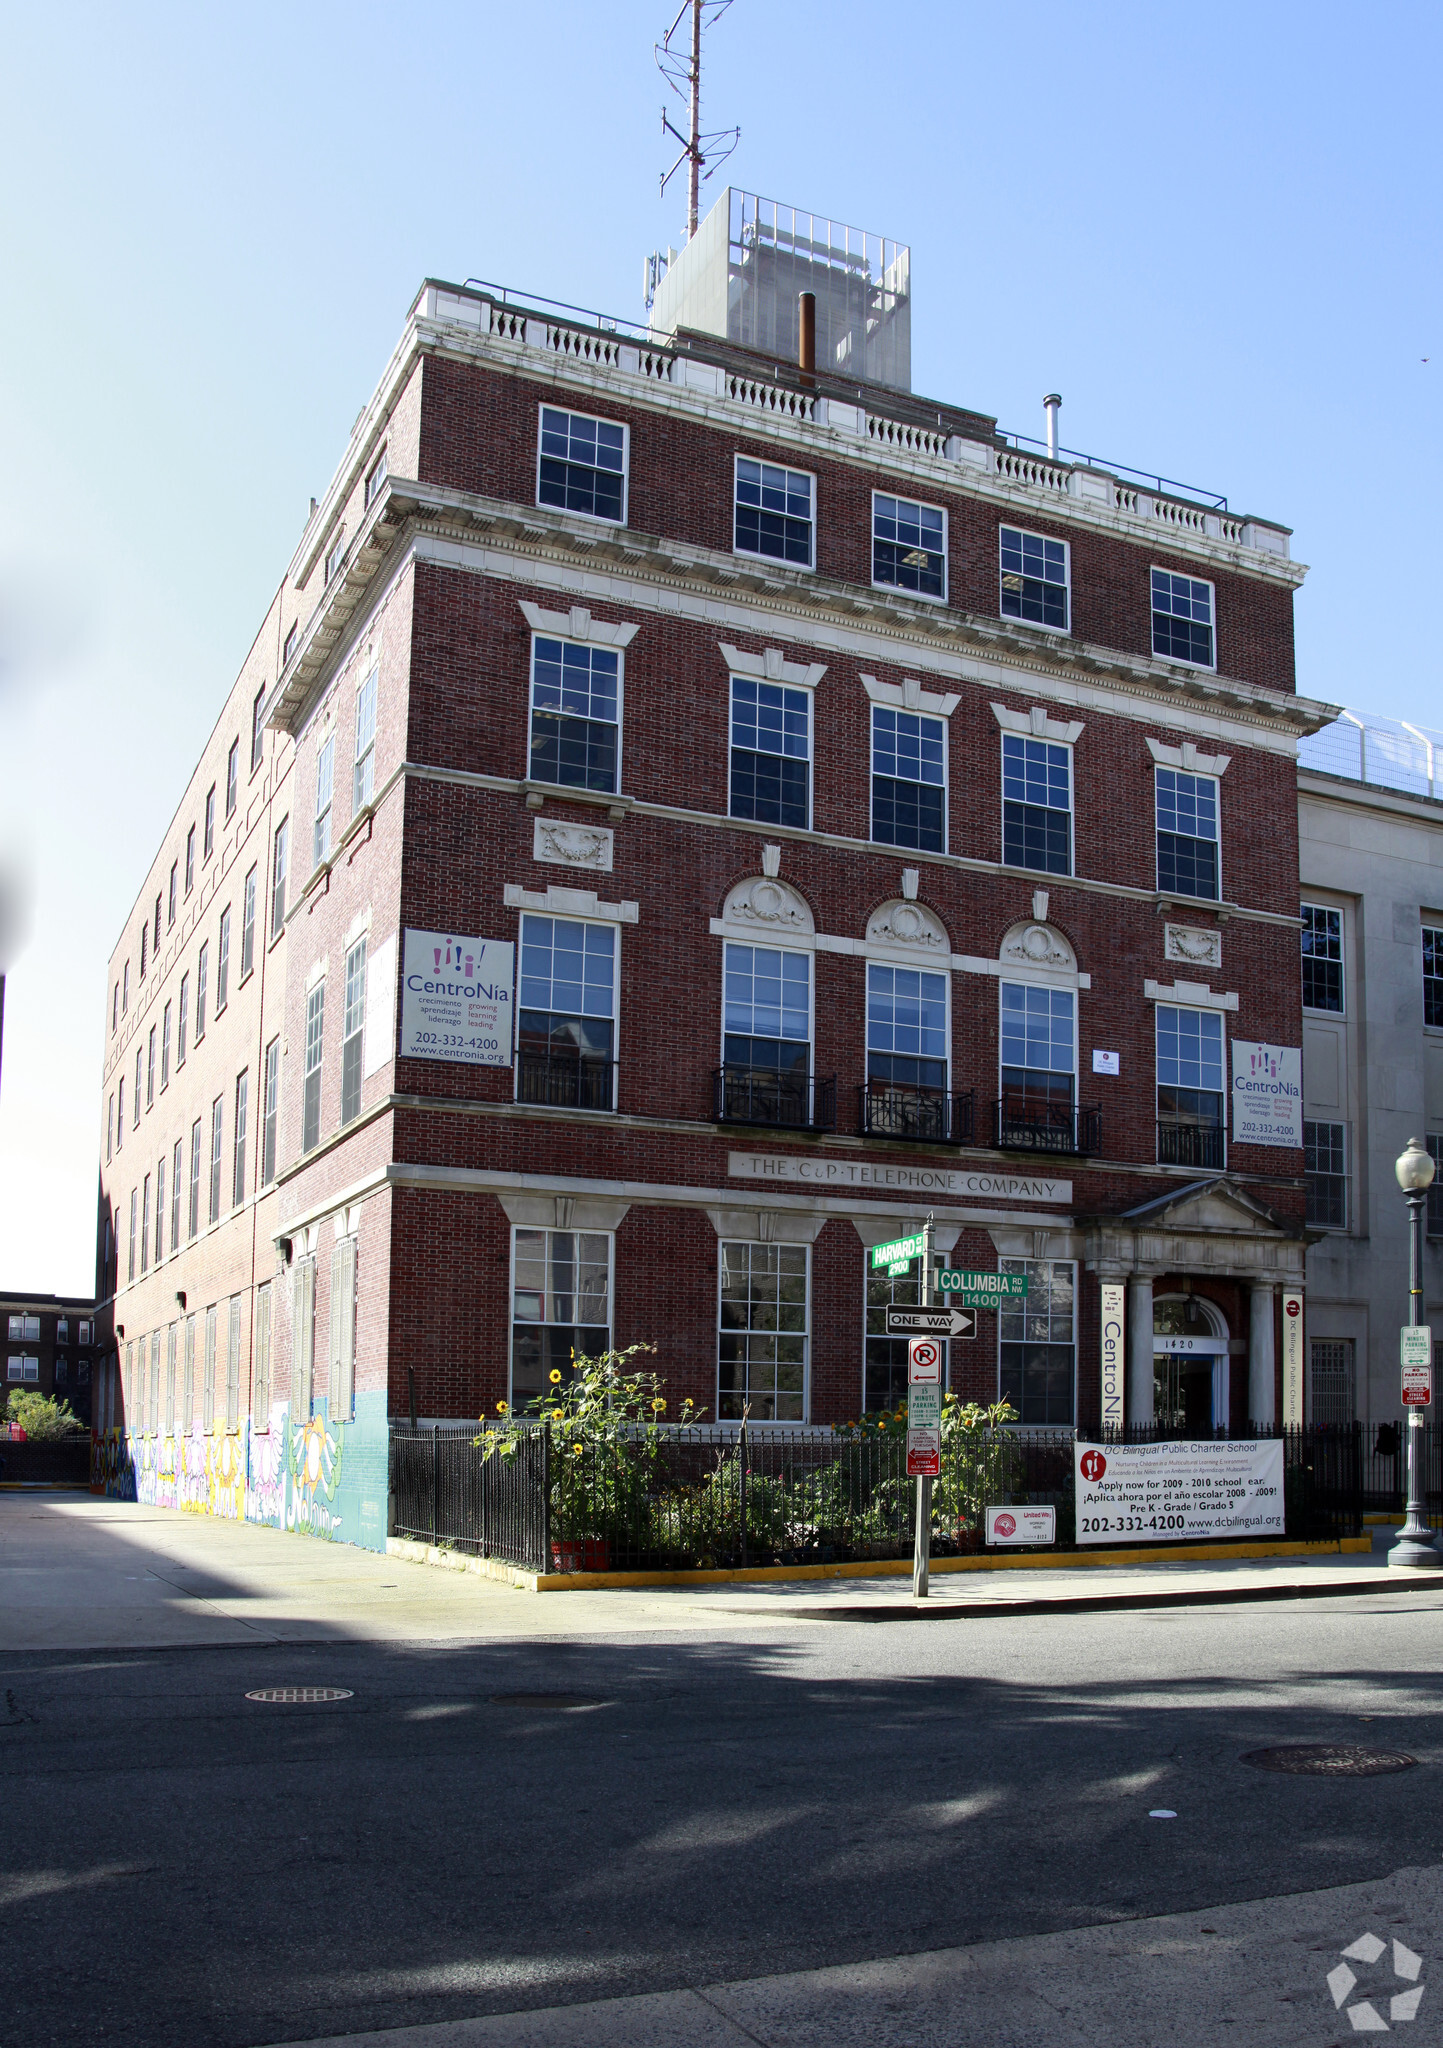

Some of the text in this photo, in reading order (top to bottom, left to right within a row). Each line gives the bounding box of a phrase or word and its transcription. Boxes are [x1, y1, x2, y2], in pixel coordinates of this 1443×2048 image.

[407, 975, 509, 1001] CentroNía
[418, 997, 462, 1007] crecimiento
[468, 1002, 498, 1013] growing
[420, 1006, 462, 1017] aprendizaje
[468, 1010, 497, 1021] learning
[428, 1015, 462, 1026] liderazgo
[468, 1020, 494, 1030] leading
[415, 1032, 498, 1050] 202-332-4200
[410, 1045, 504, 1064] www.centronia.org
[1235, 1076, 1299, 1097] CentroNía
[1242, 1121, 1294, 1136] 202-332-4200
[1239, 1132, 1299, 1146] www.centronia.org
[749, 1158, 787, 1176] THE
[847, 1166, 956, 1189] TELEPHONE
[967, 1176, 1058, 1198] COMPANY
[875, 1239, 915, 1265] HARVARD
[889, 1260, 908, 1275] 2900
[940, 1271, 1009, 1293] COLUMBIA
[1012, 1277, 1023, 1286] RD
[1011, 1285, 1023, 1294] NW
[966, 1293, 999, 1307] 1400
[891, 1315, 955, 1327] ONE WAY
[1165, 1340, 1194, 1349] 1420
[1104, 1443, 1257, 1457] DC Bilingual Public Charter School
[1098, 1481, 1123, 1491] Apply
[1147, 1480, 1160, 1488] for
[1162, 1479, 1183, 1488] 2009
[1191, 1478, 1211, 1487] 2010
[1214, 1477, 1242, 1487] school
[1083, 1493, 1115, 1504] ¡Aplica
[1117, 1493, 1144, 1501] ahora
[1146, 1494, 1162, 1502] por
[1164, 1491, 1172, 1499] el
[1174, 1491, 1190, 1499] año
[1193, 1490, 1224, 1499] escolar
[1226, 1489, 1246, 1497] 2008
[1130, 1504, 1146, 1513] Pre
[1148, 1504, 1156, 1512] K
[1163, 1502, 1191, 1511] Grade
[1199, 1501, 1227, 1510] Grado
[1229, 1501, 1234, 1509] 5
[1081, 1515, 1281, 1532] 202-332-4200 www.dcbilingual.org
